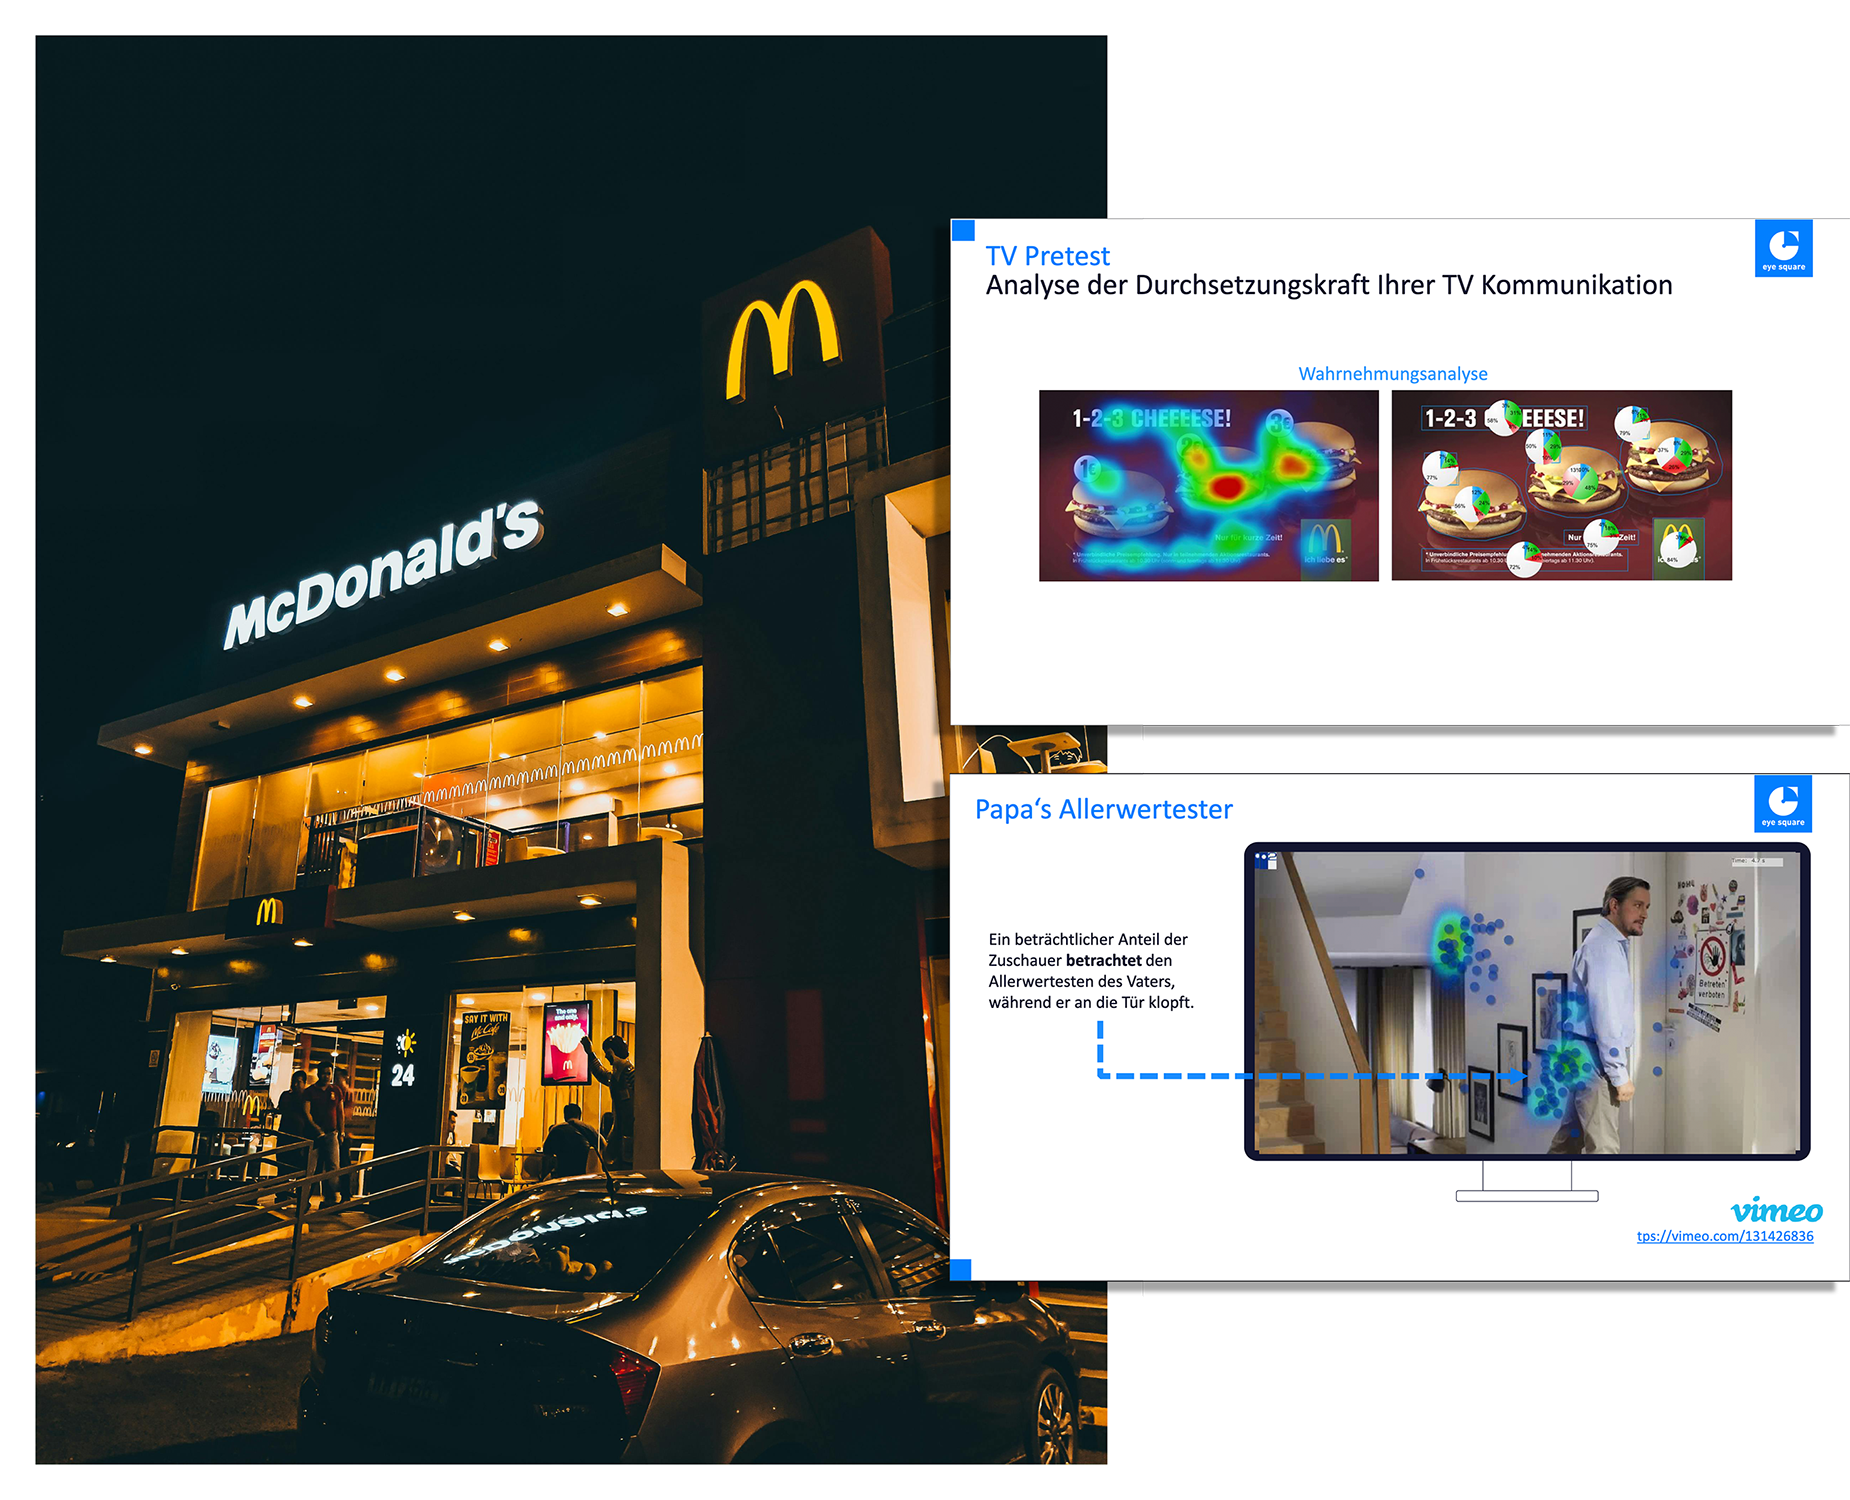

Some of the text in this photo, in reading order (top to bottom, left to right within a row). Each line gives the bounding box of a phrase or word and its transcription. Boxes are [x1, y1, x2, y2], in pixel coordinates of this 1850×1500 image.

[1073, 408, 1231, 428] 1-2-3 CHEEEESE!
[1270, 413, 1291, 433] 3€
[1426, 408, 1476, 428] 1-2-3
[223, 500, 543, 651] McDonald's
[1699, 979, 1726, 988] Betreten
[1698, 991, 1725, 999] verboten
[464, 1013, 508, 1024] SAY IT WITH
[391, 1063, 415, 1087] 24
